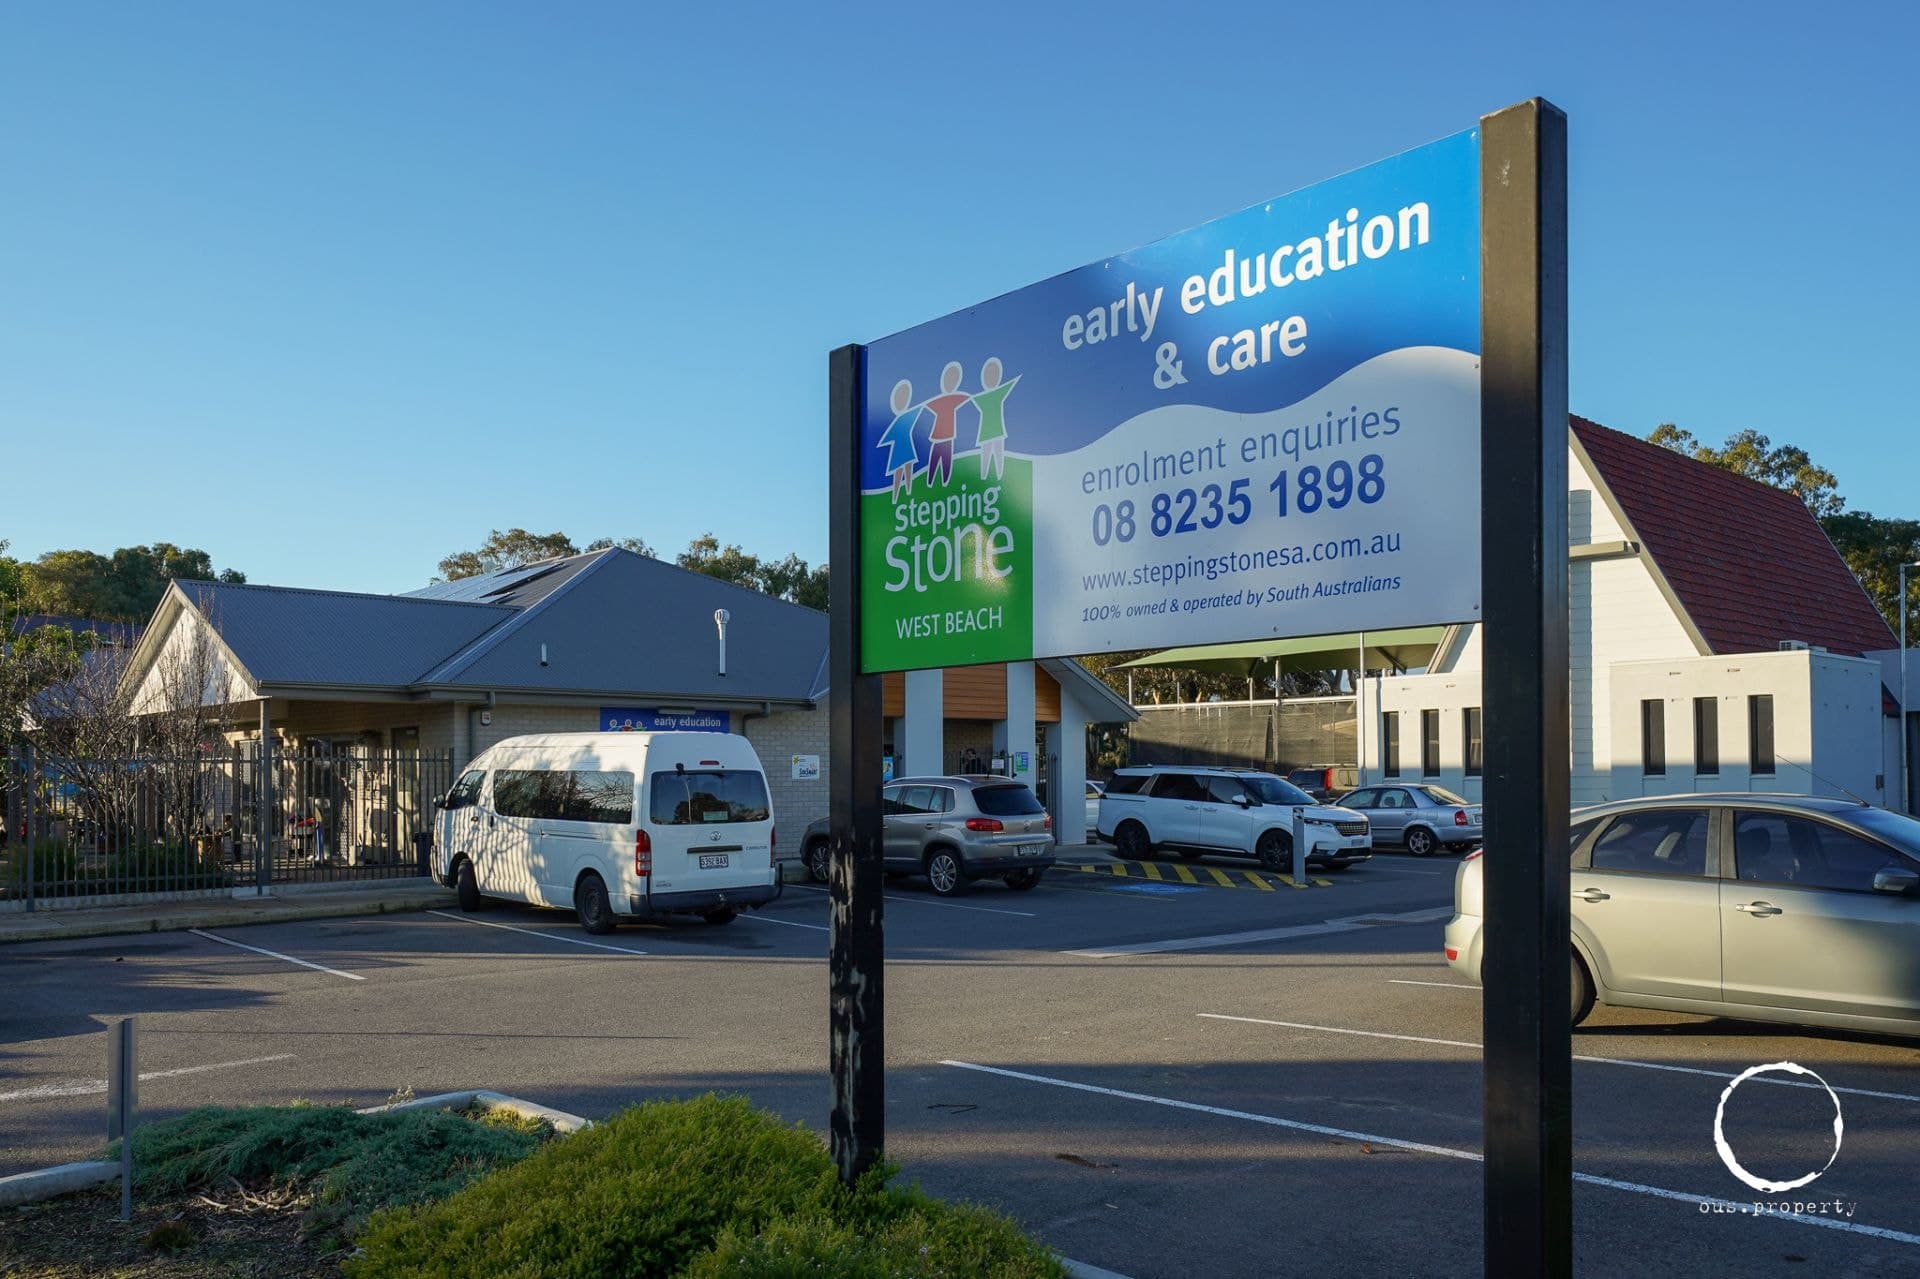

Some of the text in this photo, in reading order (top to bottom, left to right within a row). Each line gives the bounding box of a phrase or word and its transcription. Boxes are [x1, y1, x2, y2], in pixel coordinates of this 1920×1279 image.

[1062, 201, 1430, 351] early education
[1152, 315, 1308, 390] & care
[1081, 405, 1401, 494] enrolment enquiries
[1092, 454, 1386, 546] 08 8235 1898
[1081, 532, 1401, 591] www.steppingstonesa.com.au
[895, 606, 1003, 640] WEST BEACH
[1081, 575, 1401, 622] 100% owned & operated by South Australians
[654, 716, 721, 728] early education
